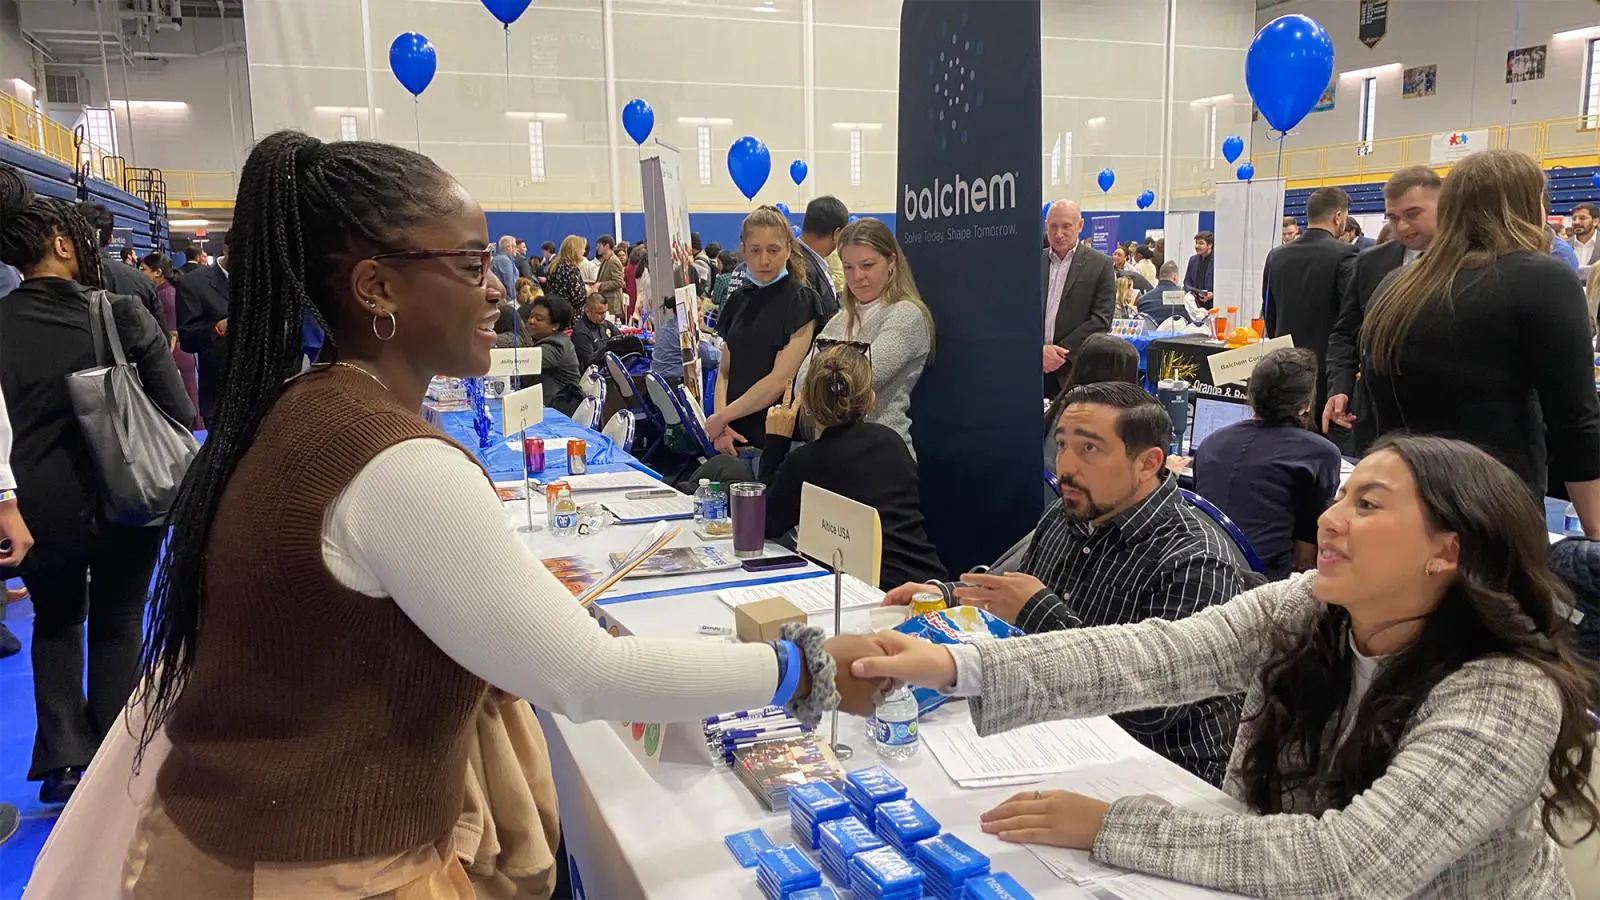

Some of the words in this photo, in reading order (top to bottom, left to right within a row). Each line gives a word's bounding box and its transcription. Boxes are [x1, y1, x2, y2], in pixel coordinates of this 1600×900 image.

[904, 172, 1016, 221] balchem
[904, 232, 922, 244] Solve
[947, 228, 972, 240] Shape
[973, 224, 1018, 237] Tomorrow.
[1220, 360, 1247, 370] Balchem
[1225, 388, 1231, 397] &
[821, 518, 838, 536] Altice
[837, 524, 850, 541] USA
